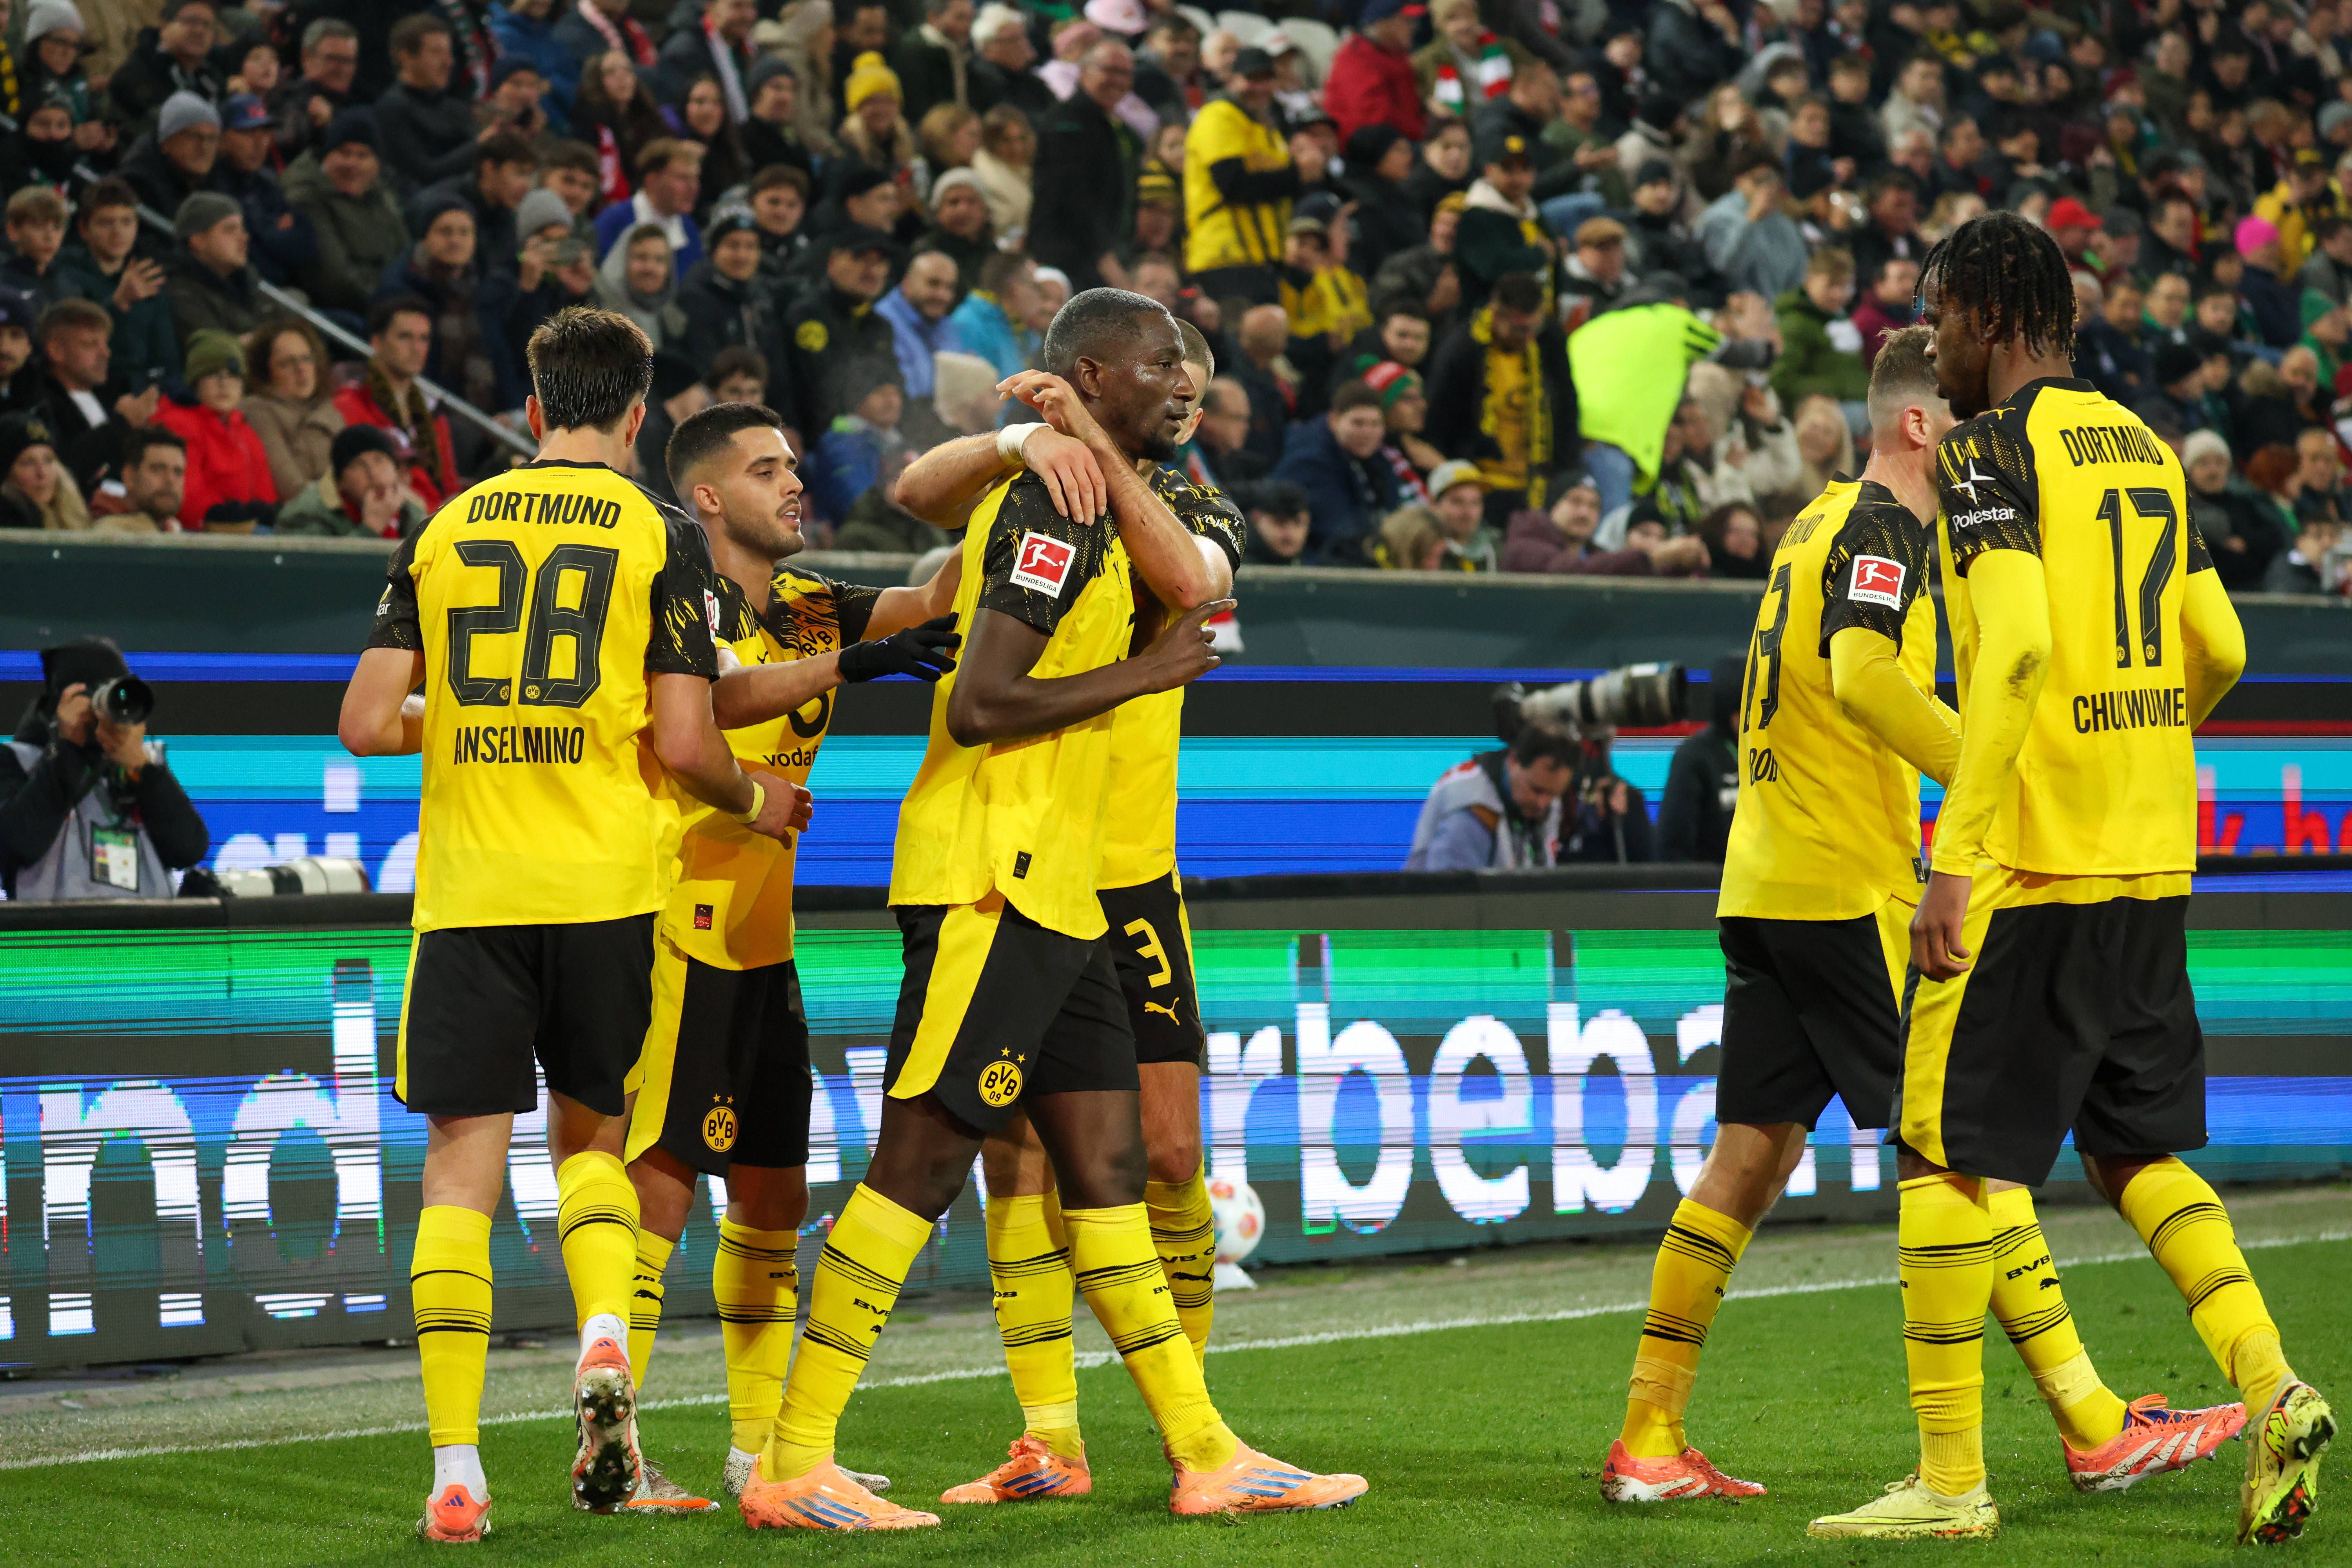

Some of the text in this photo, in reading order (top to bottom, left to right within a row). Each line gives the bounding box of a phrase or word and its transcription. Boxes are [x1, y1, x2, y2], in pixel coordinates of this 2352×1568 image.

[2059, 426, 2163, 466] DORTMUND
[467, 492, 621, 529] DORTMUND
[1952, 507, 2016, 533] Polestar
[1016, 574, 1057, 592] BUNDESLIGA
[2096, 487, 2178, 668] 17
[1853, 592, 1896, 606] BUNDESLIGA
[447, 540, 619, 709] 28
[527, 686, 538, 695] BVB
[454, 726, 584, 765] ANSELMINO
[1123, 918, 1171, 988] 3
[984, 1065, 1018, 1097] BVB
[989, 1091, 1001, 1102] 09
[708, 1111, 733, 1138] BVB
[715, 1138, 724, 1147] 09
[2005, 1254, 2050, 1280] BVB
